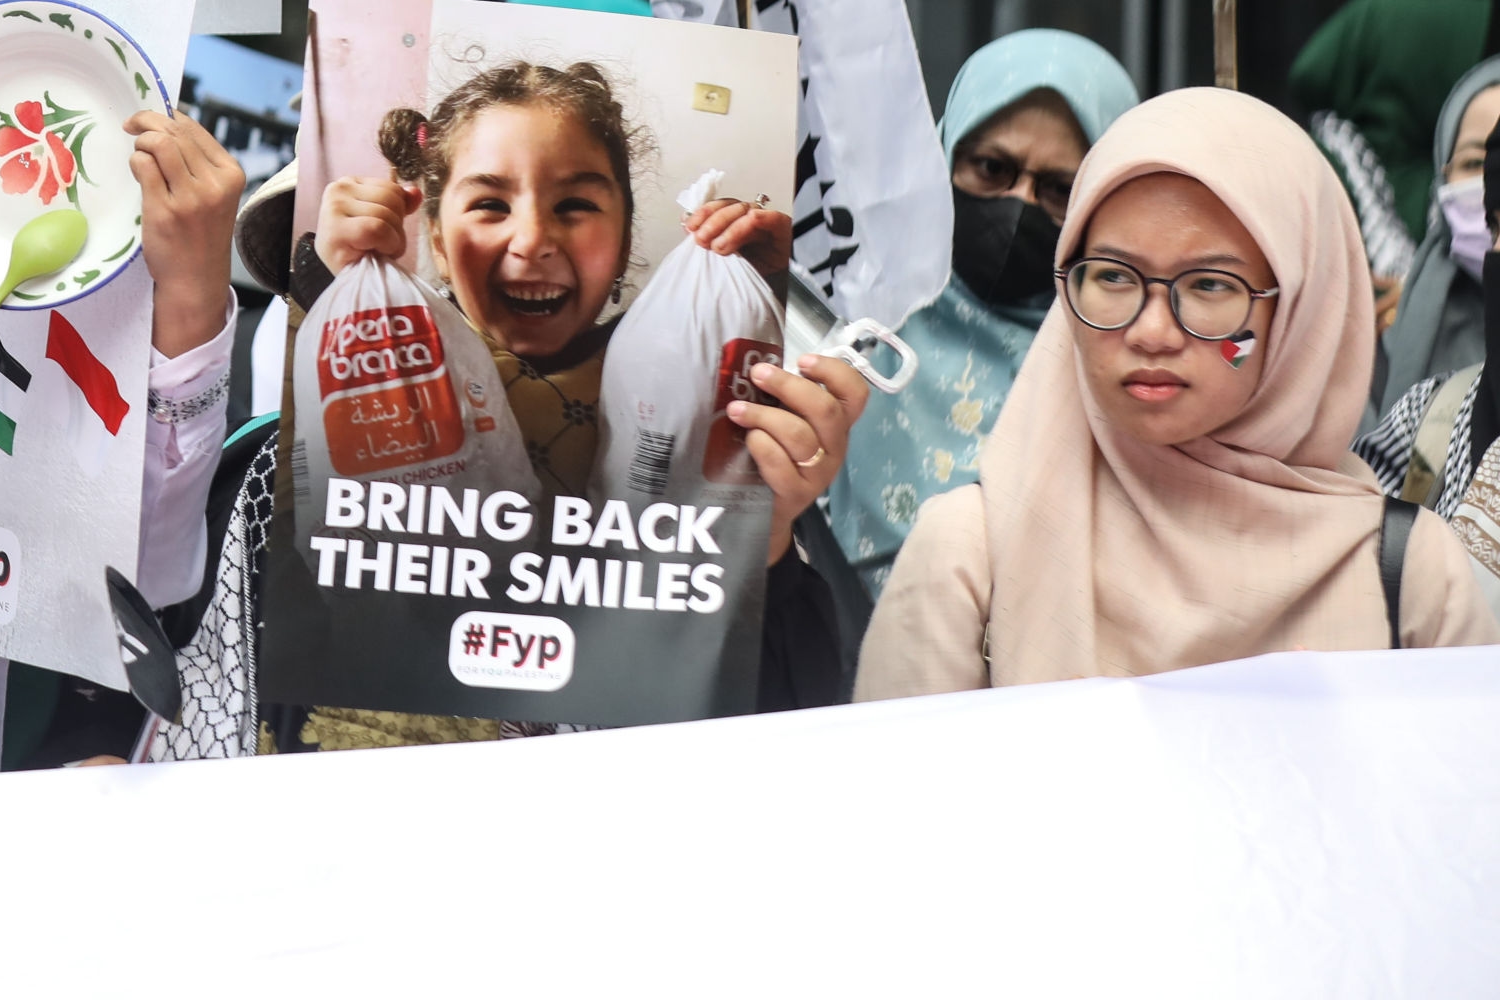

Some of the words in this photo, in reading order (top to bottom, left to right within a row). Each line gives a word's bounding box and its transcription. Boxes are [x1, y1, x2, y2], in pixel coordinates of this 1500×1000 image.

[329, 342, 433, 380] branca
[350, 386, 433, 428] الريشة
[355, 420, 441, 462] البيضاء
[401, 459, 467, 488] CHICKEN
[325, 477, 533, 544] BRING
[551, 495, 725, 557] BACK
[310, 537, 492, 600] THEIR
[505, 552, 725, 614] SMILES
[463, 623, 562, 669] #Fyp
